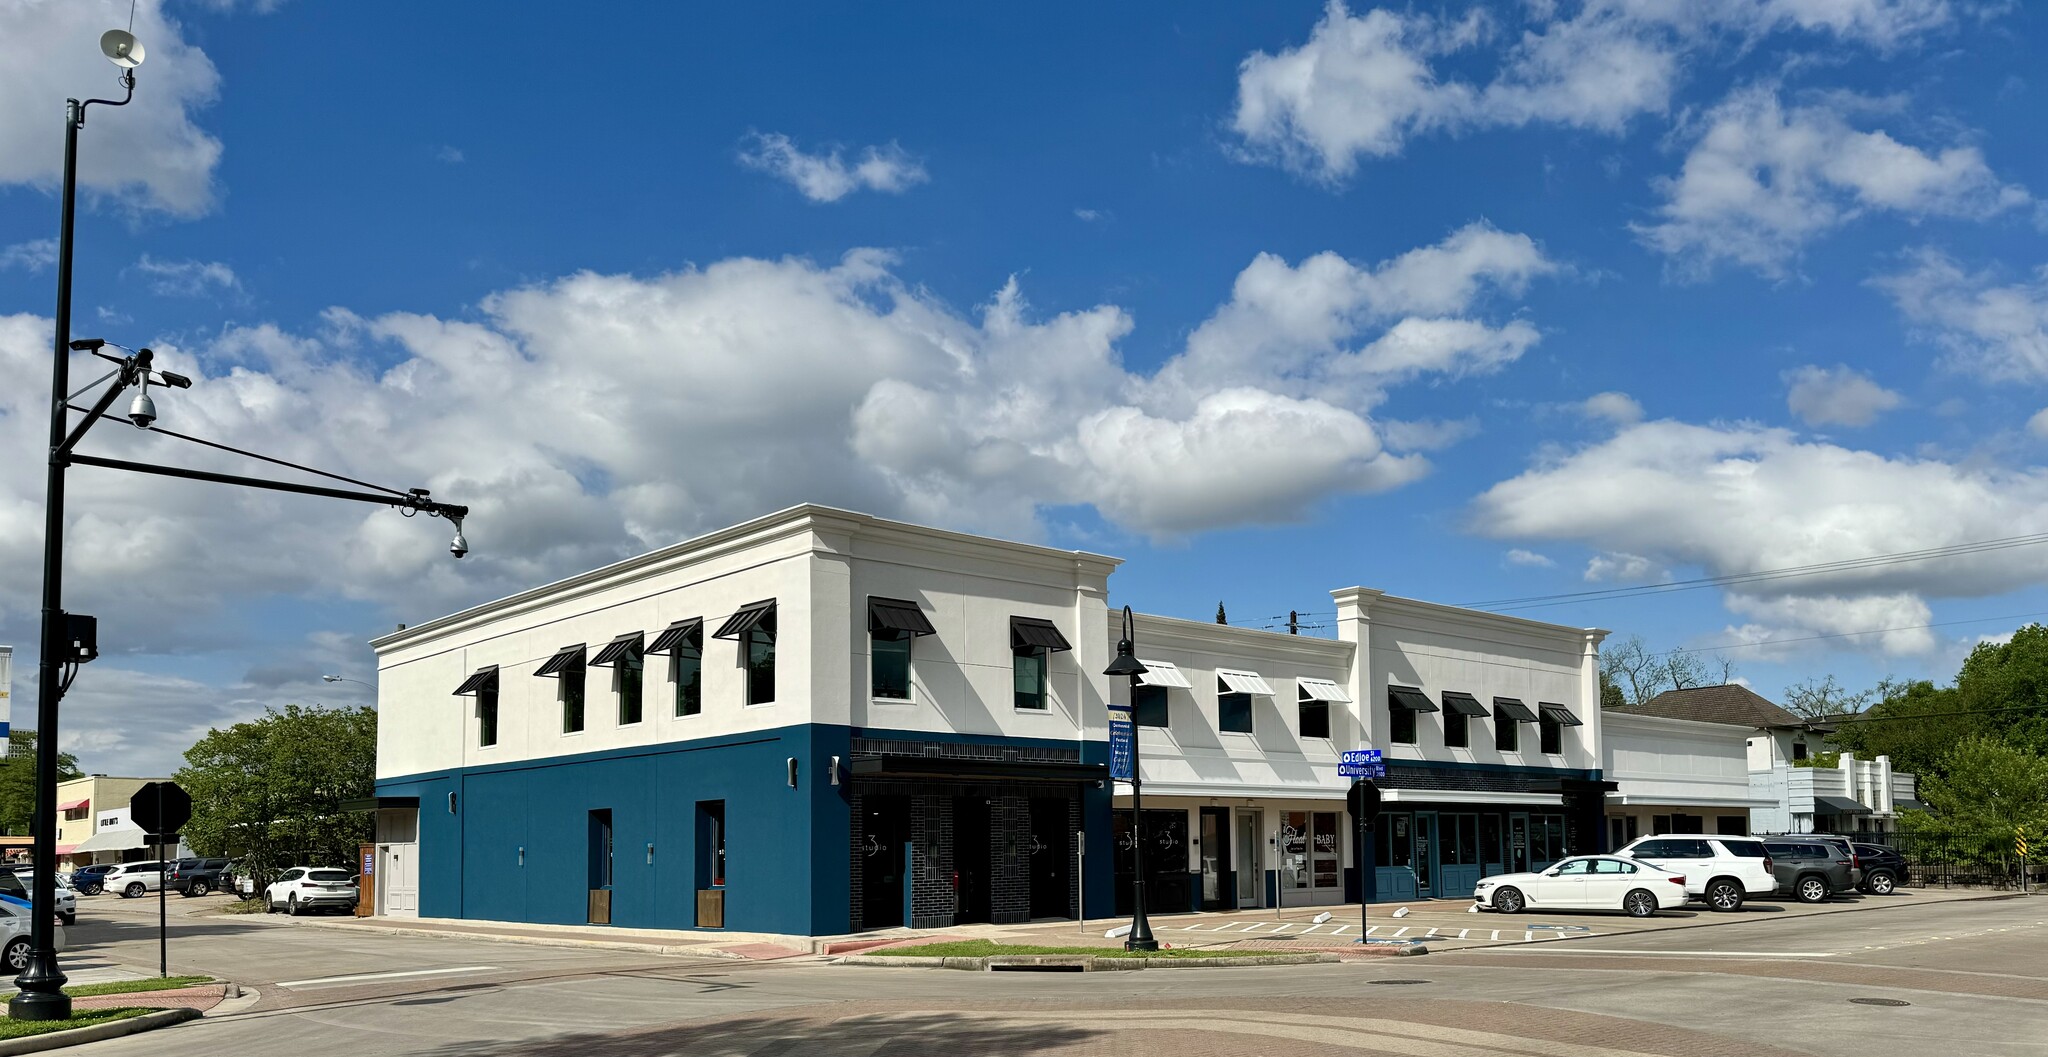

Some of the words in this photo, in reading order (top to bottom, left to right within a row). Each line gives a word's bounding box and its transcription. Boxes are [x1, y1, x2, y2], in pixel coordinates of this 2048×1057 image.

[1350, 752, 1370, 763] Edloe
[1346, 764, 1375, 777] University
[1316, 834, 1335, 845] BABY
